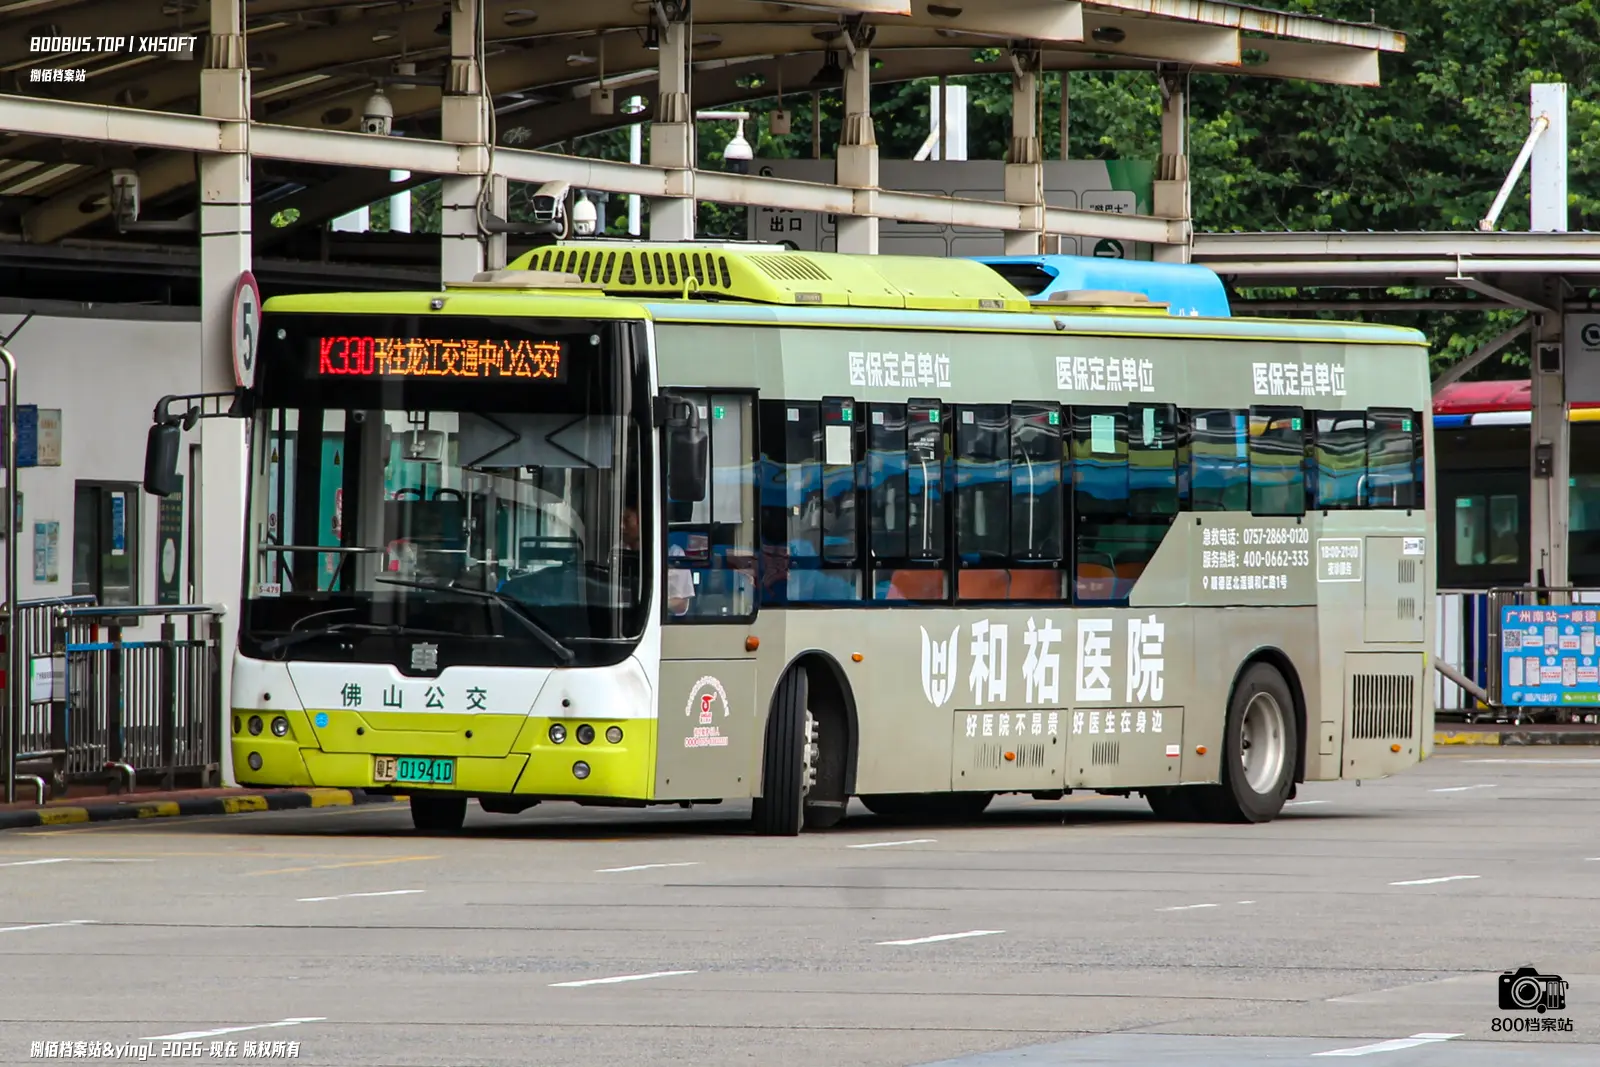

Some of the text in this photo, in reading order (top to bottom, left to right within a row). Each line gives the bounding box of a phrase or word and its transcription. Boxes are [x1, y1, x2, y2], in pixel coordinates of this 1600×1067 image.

[770, 215, 802, 232] 出口
[243, 302, 253, 371] 5
[848, 351, 952, 388] 医保定点单位
[1055, 356, 1155, 392] 医保定点单位
[1252, 362, 1347, 396] 医保定点单位
[1243, 528, 1309, 544] 0757-2868-0120
[1243, 550, 1309, 567] 400-0662-333
[969, 614, 1165, 705] 和祐医院
[341, 683, 487, 710] 佛山公交
[966, 709, 1163, 737] 好医院不昂贵 好医生在身边
